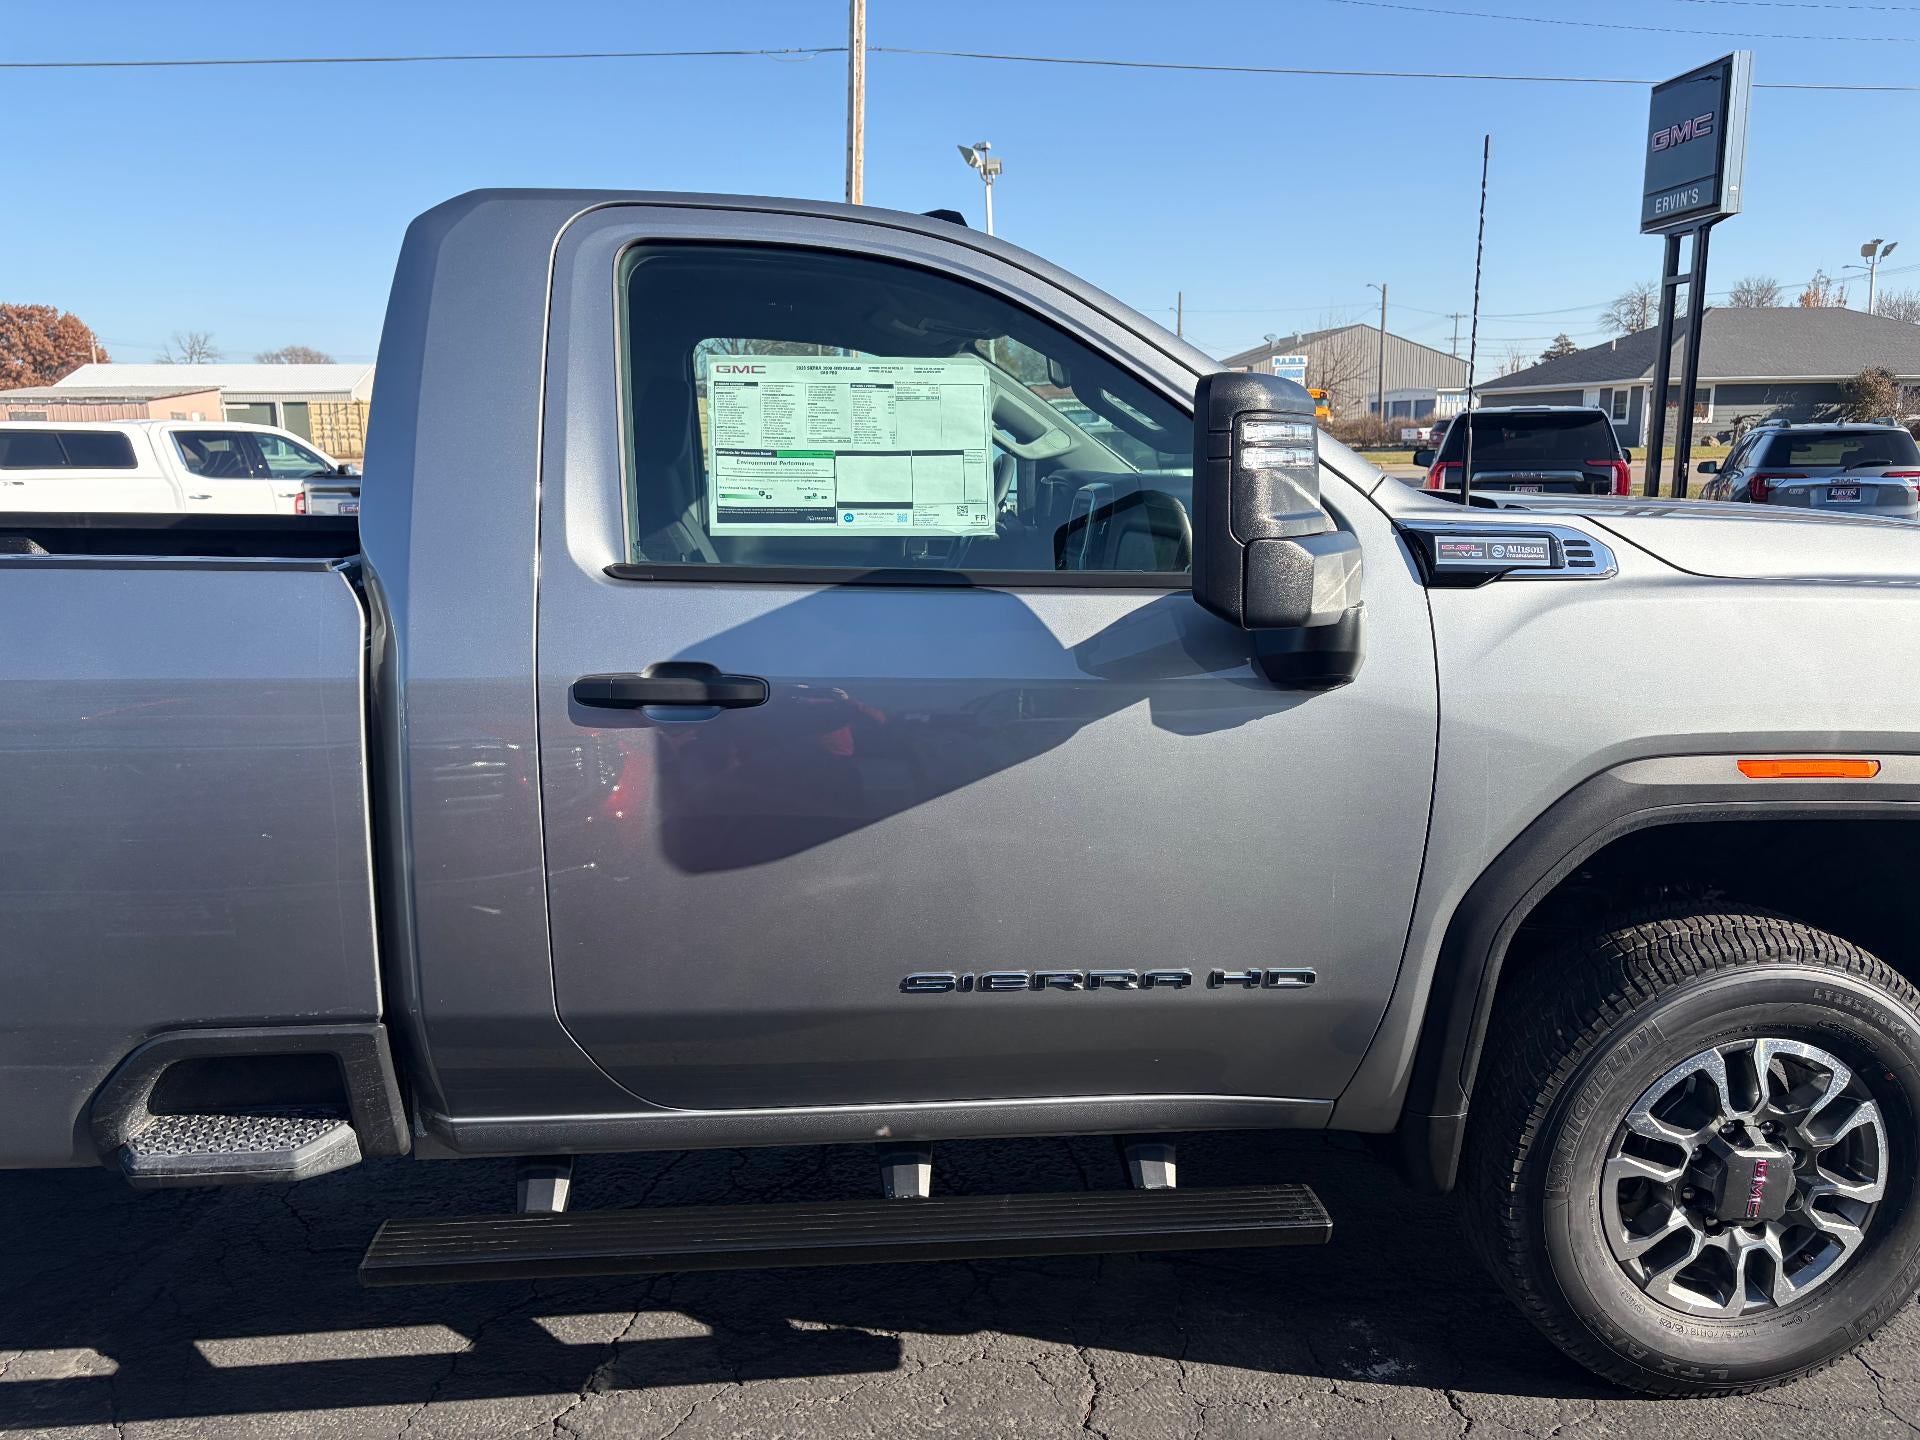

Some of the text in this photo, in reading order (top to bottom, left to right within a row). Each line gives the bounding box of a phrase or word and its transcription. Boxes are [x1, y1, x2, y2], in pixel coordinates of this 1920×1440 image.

[1652, 111, 1714, 152] GMC
[1655, 188, 1699, 214] ERVIN'S
[716, 365, 767, 374] GMC
[1506, 545, 1545, 554] Allison
[901, 967, 1318, 992] SIERRA HD
[1557, 1027, 1651, 1157] MICHELIN
[1745, 1159, 1768, 1218] GMC
[1660, 1357, 1729, 1380] LTX
